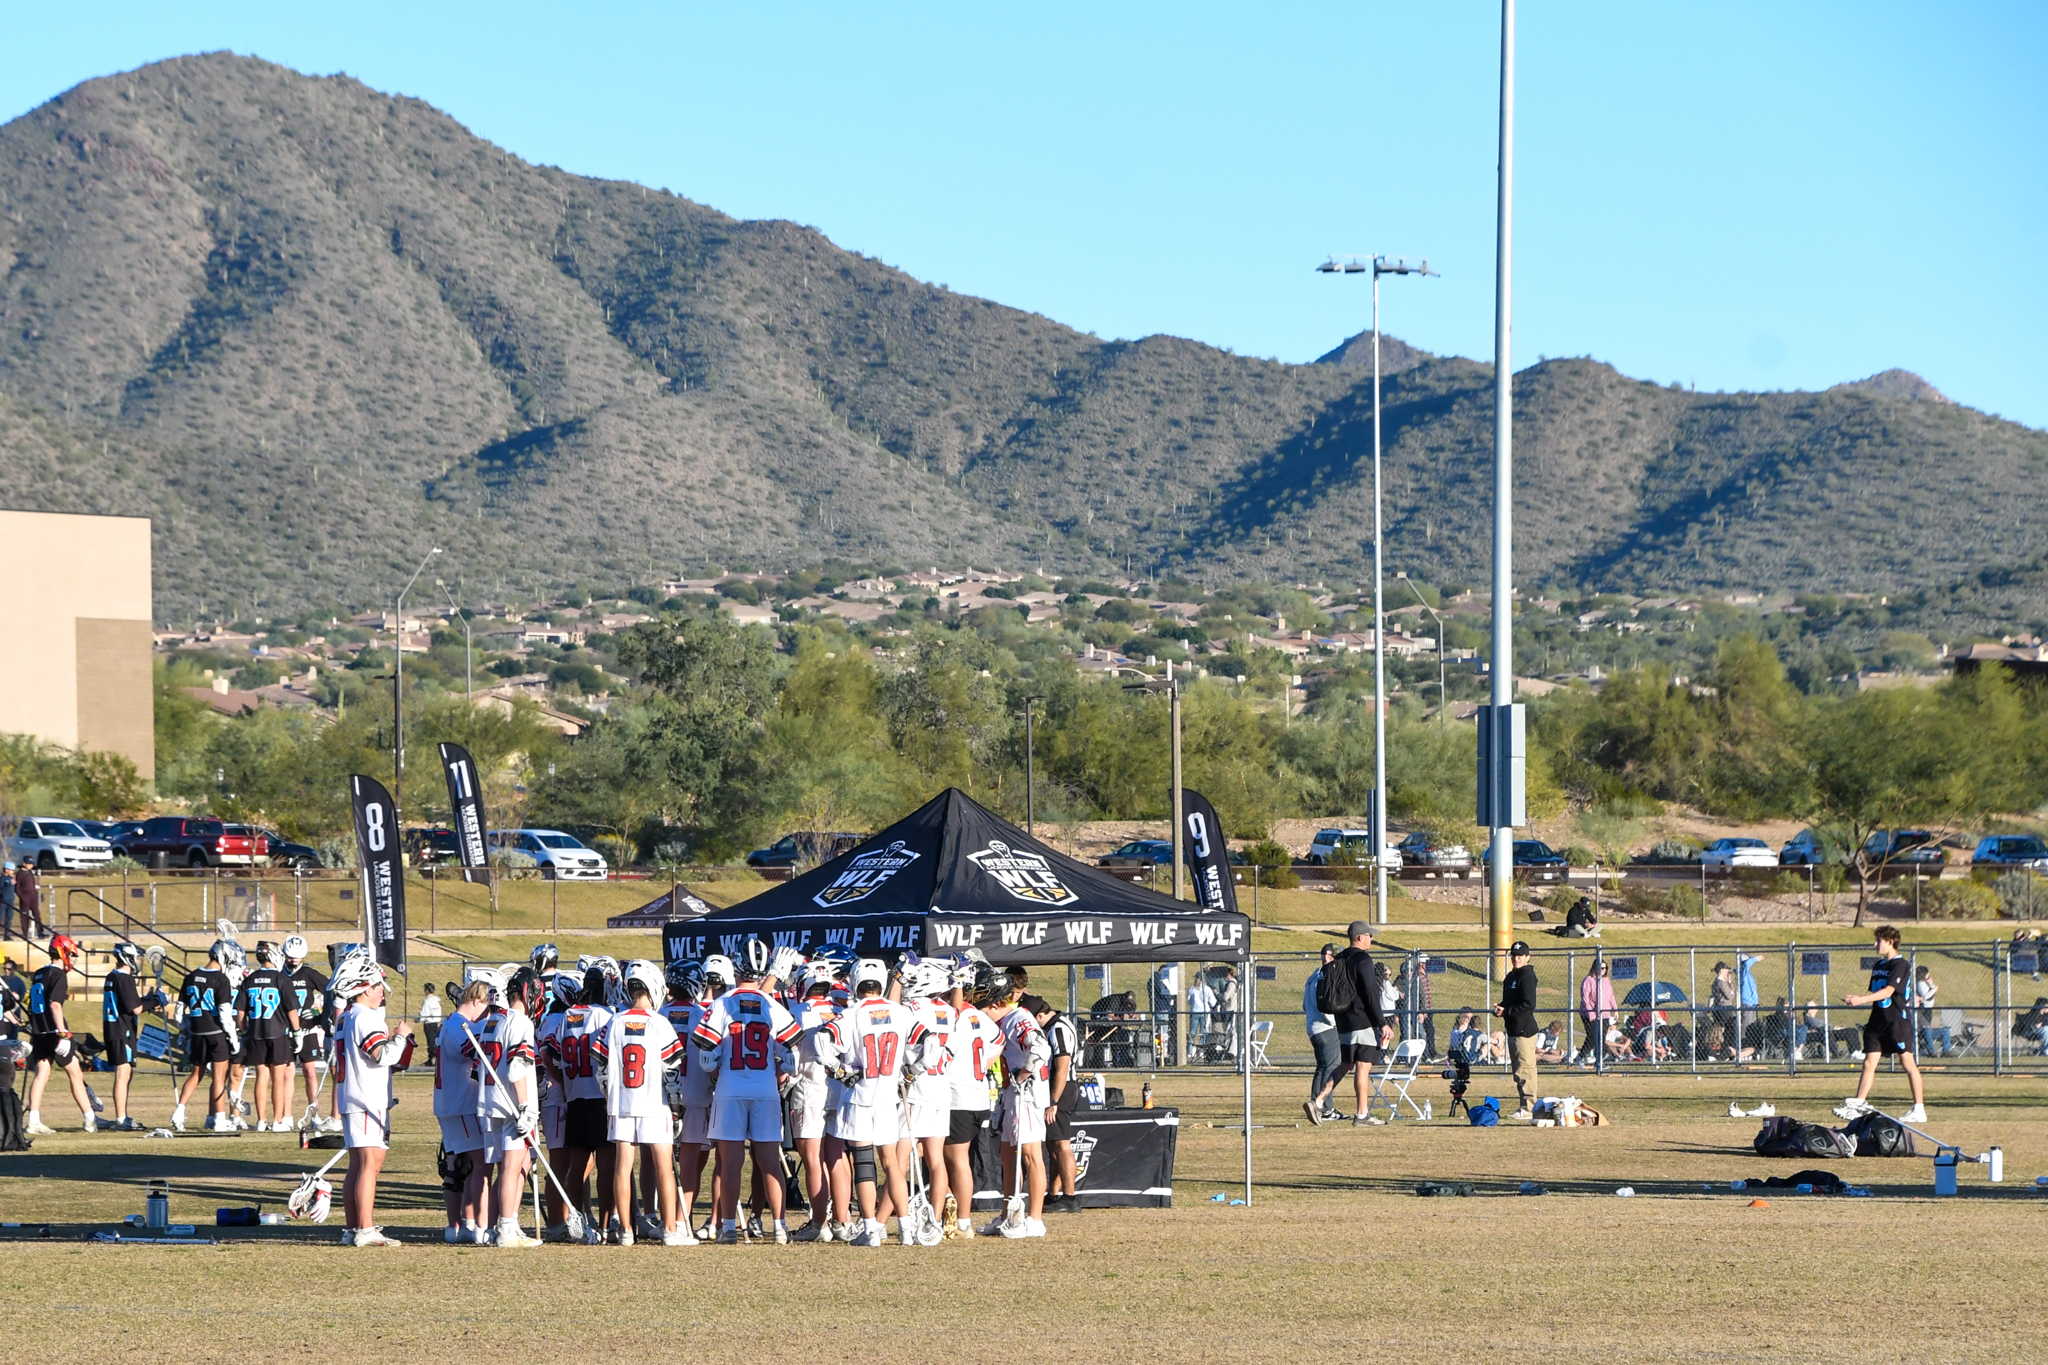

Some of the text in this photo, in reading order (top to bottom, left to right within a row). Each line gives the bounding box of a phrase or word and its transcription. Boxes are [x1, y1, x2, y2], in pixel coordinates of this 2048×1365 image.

[450, 760, 472, 799] 11
[365, 802, 386, 852] 8
[465, 803, 485, 865] WESTERN
[1187, 812, 1211, 858] 9
[831, 870, 898, 888] WLF
[855, 858, 908, 866] WESTERN
[980, 858, 1043, 867] WESTERN
[987, 870, 1060, 888] WLF
[373, 861, 384, 944] LACROSSE FEDERATION
[379, 860, 394, 940] WESTERN
[1206, 865, 1225, 911] WEST
[669, 936, 706, 959] WLF
[879, 925, 920, 948] WLF
[933, 921, 1243, 947] WLF WLF WLF WLF WLF
[186, 985, 217, 1017] 24
[247, 987, 280, 1019] 39
[562, 1034, 593, 1080] 91
[728, 1021, 771, 1070] 19
[863, 1031, 899, 1079] 10
[622, 1043, 646, 1088] 8
[1087, 1086, 1104, 1103] 05
[1073, 1151, 1092, 1166] LF
